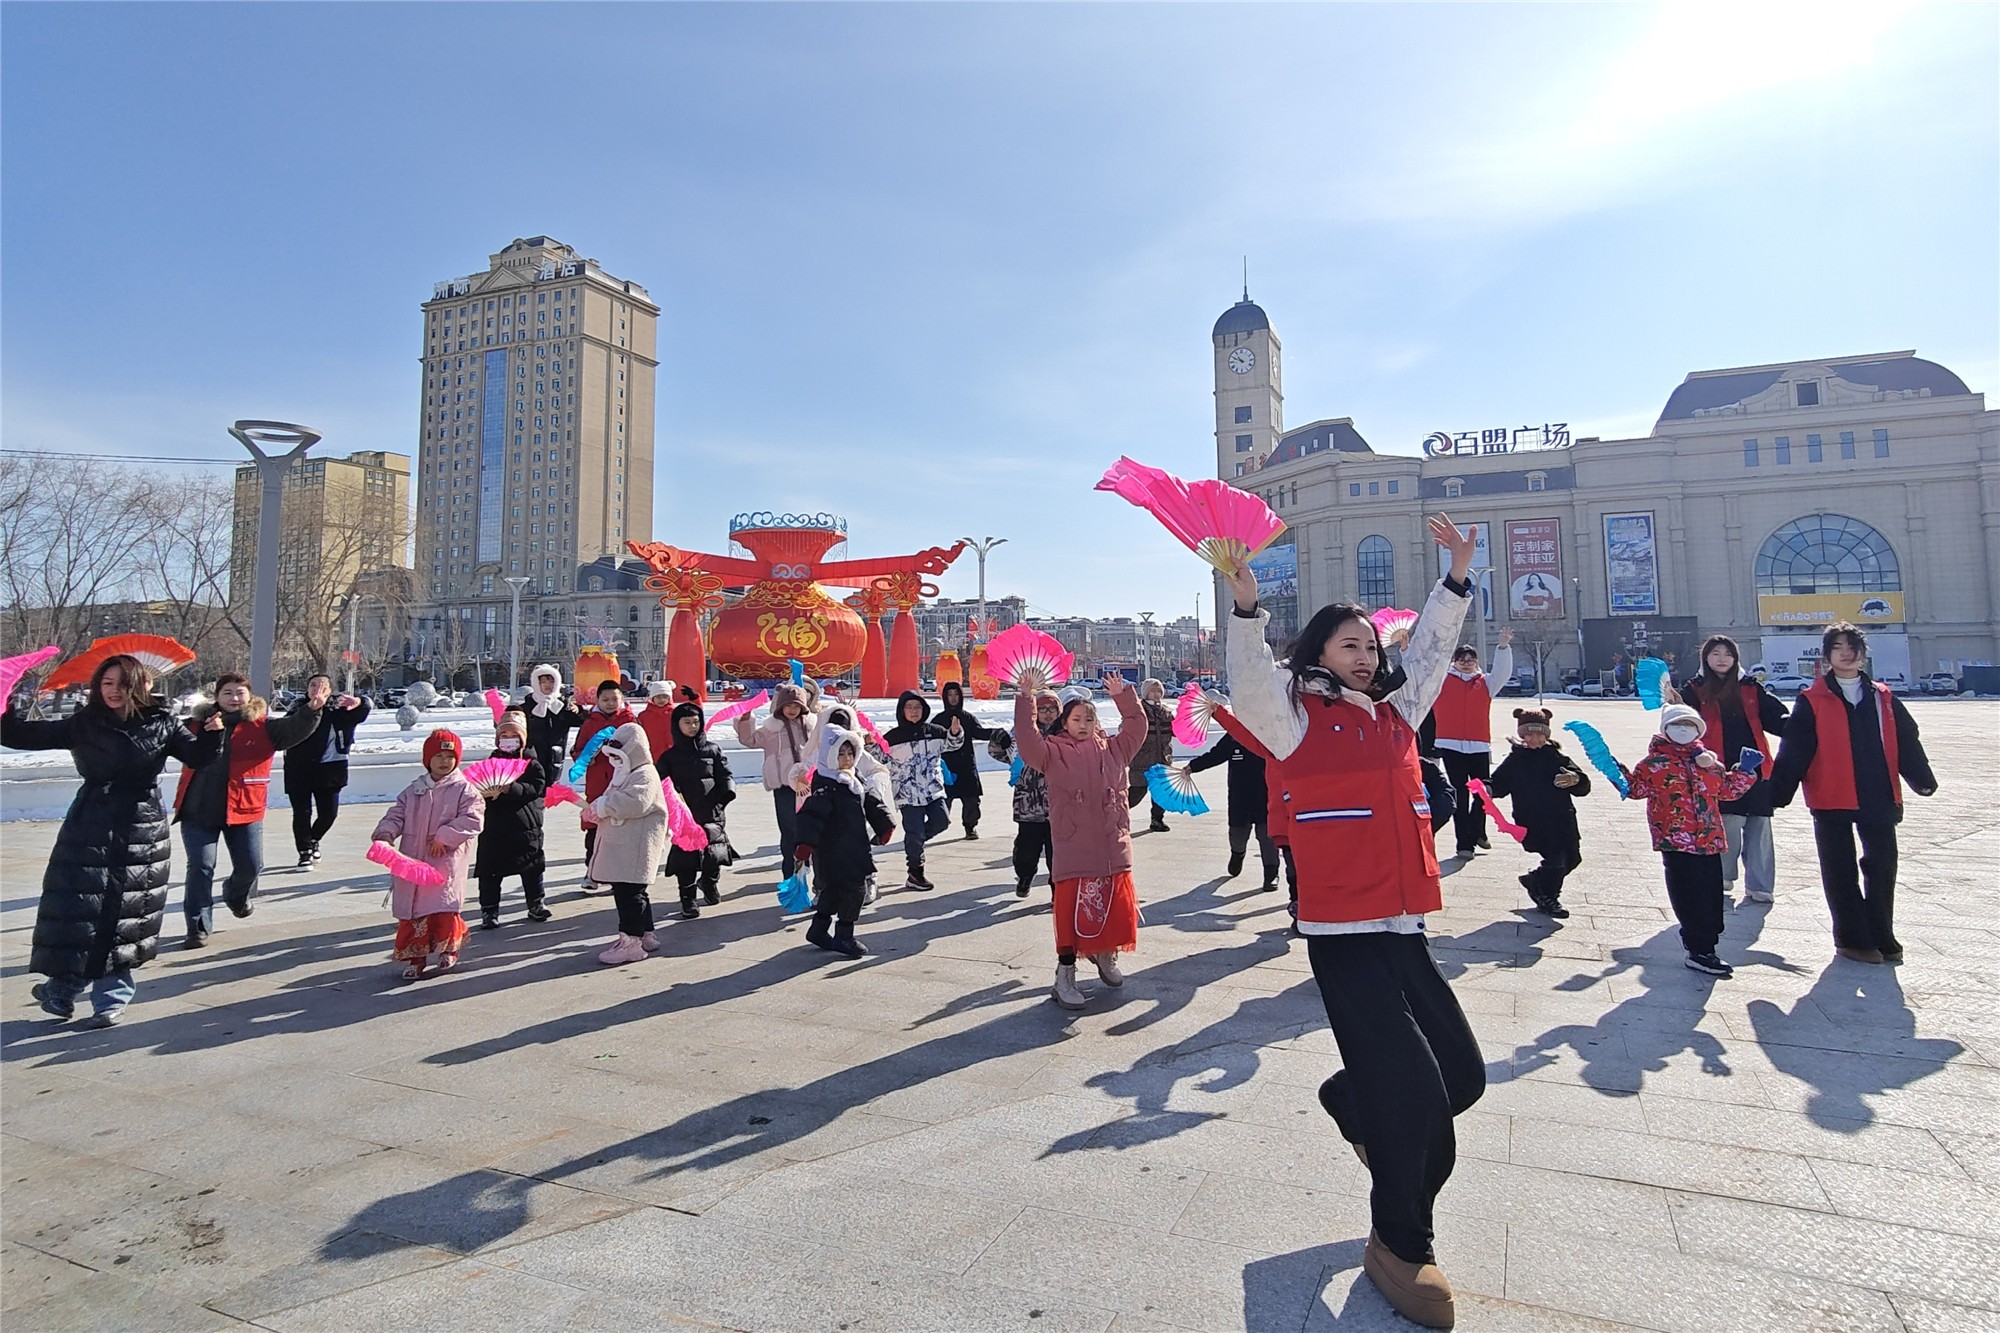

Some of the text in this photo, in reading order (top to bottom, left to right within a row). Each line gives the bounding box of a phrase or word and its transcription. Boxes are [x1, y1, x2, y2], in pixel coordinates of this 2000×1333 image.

[1452, 423, 1570, 456] 百盟广场
[1512, 540, 1555, 552] 定制家
[1512, 552, 1556, 565] 索菲亚
[774, 617, 816, 649] 福
